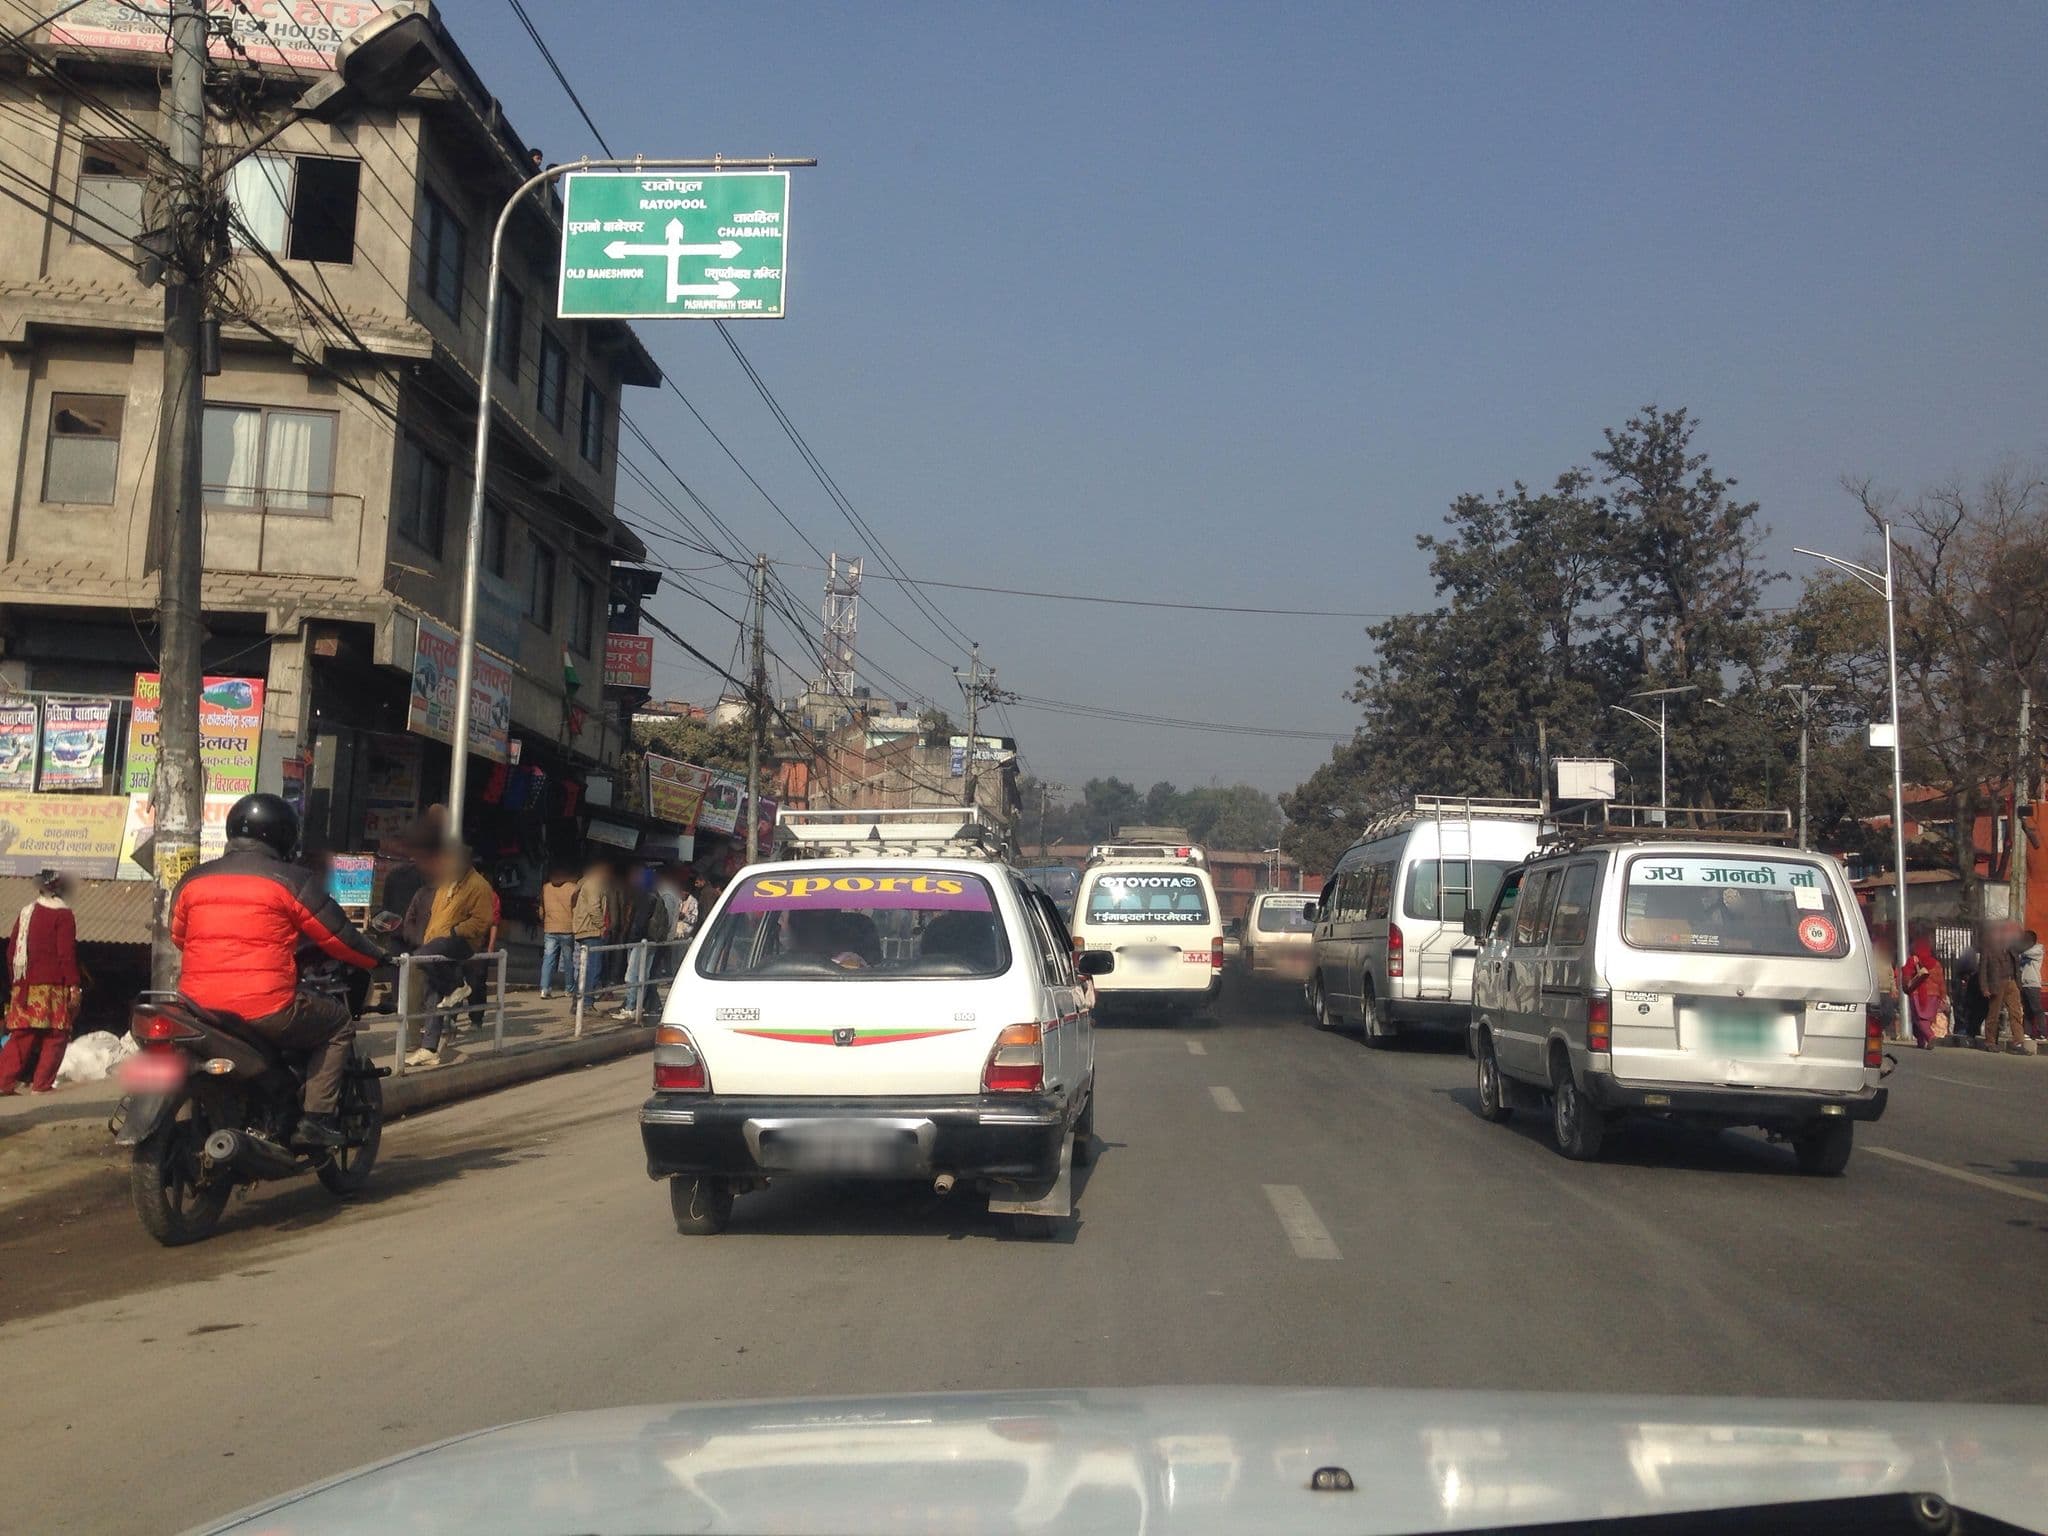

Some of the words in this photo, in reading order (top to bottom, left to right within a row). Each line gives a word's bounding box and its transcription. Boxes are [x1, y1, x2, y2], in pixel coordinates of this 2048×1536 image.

[274, 22, 343, 42] HOUSE
[641, 178, 702, 193] रातोपुल
[640, 199, 707, 209] RATOPOOL
[717, 227, 781, 237] CHABAHIL
[566, 268, 585, 278] OLD
[587, 268, 643, 279] BANESHWOR
[737, 299, 762, 310] TEMPLE
[1643, 866, 1684, 881] जय
[1700, 867, 1776, 885] जानकी
[1116, 877, 1181, 888] TOYOTA
[1817, 1003, 1849, 1012] Omni
